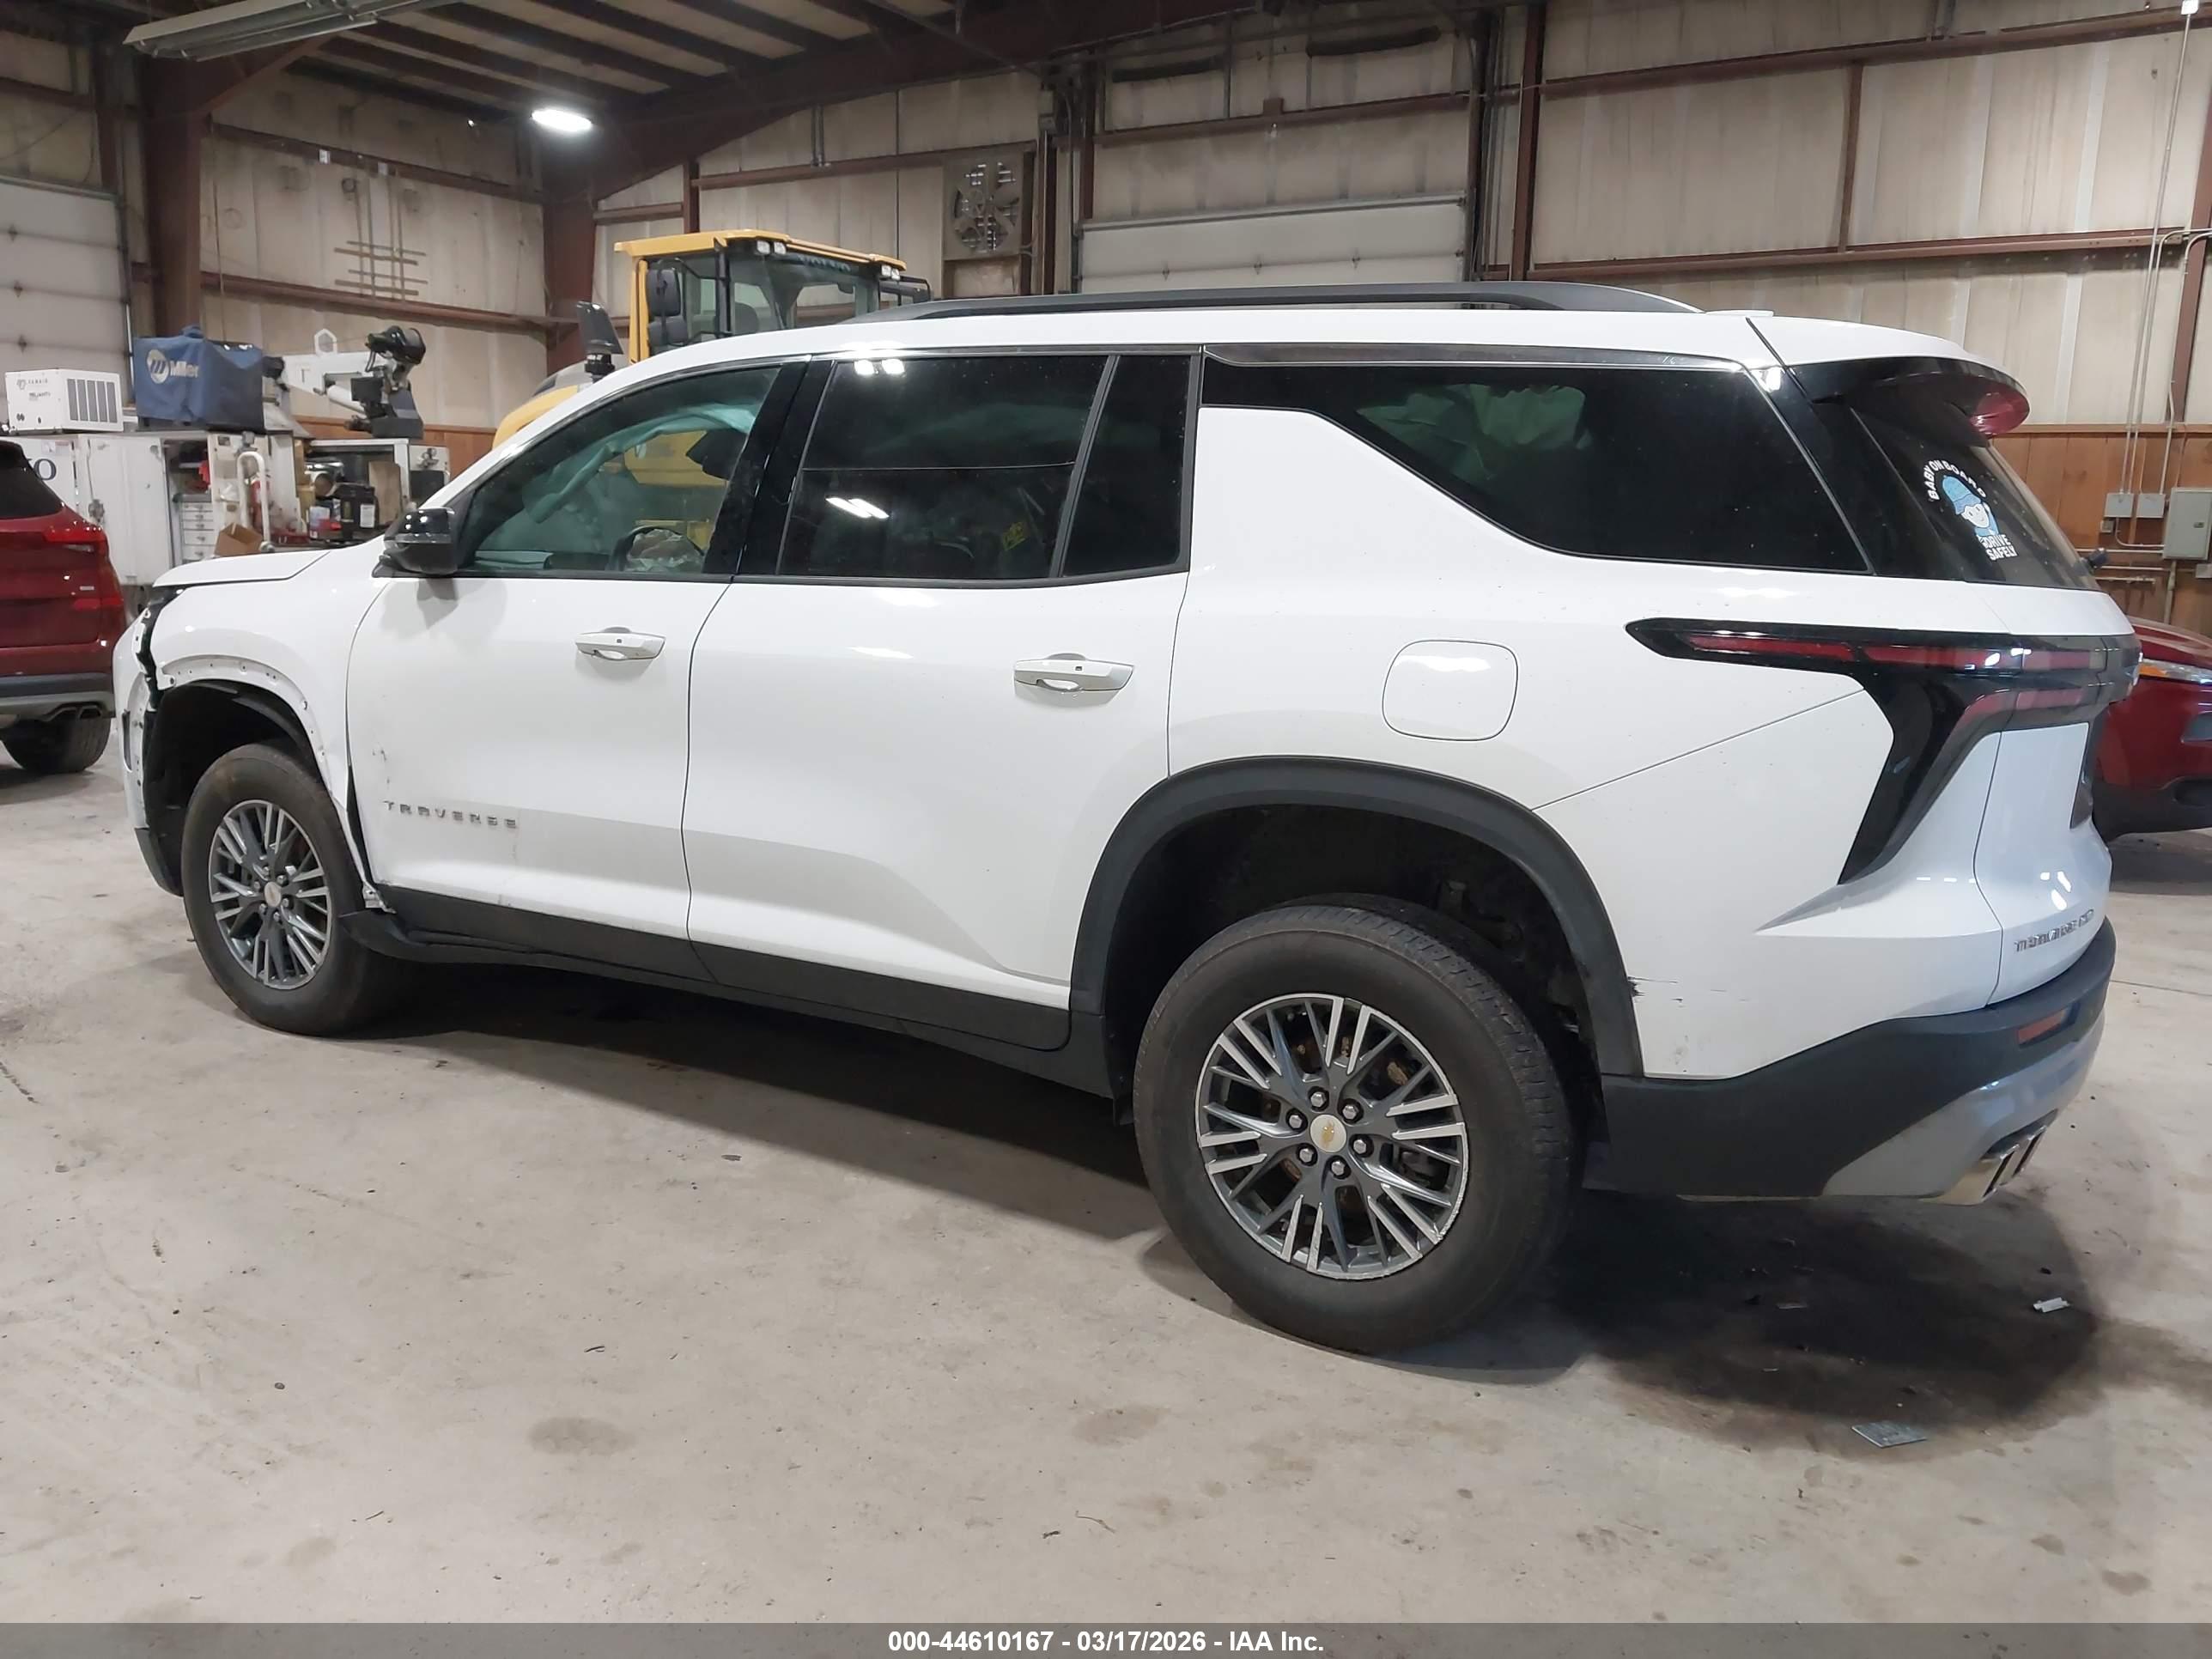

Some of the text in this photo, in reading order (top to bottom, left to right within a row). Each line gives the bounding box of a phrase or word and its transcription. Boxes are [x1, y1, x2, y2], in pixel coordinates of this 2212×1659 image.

[1923, 459, 1986, 500] BABY ON BOARD
[1982, 534, 2011, 549] DRIVE
[1985, 545, 2018, 561] SAFELY
[383, 799, 517, 829] TRAVERSE
